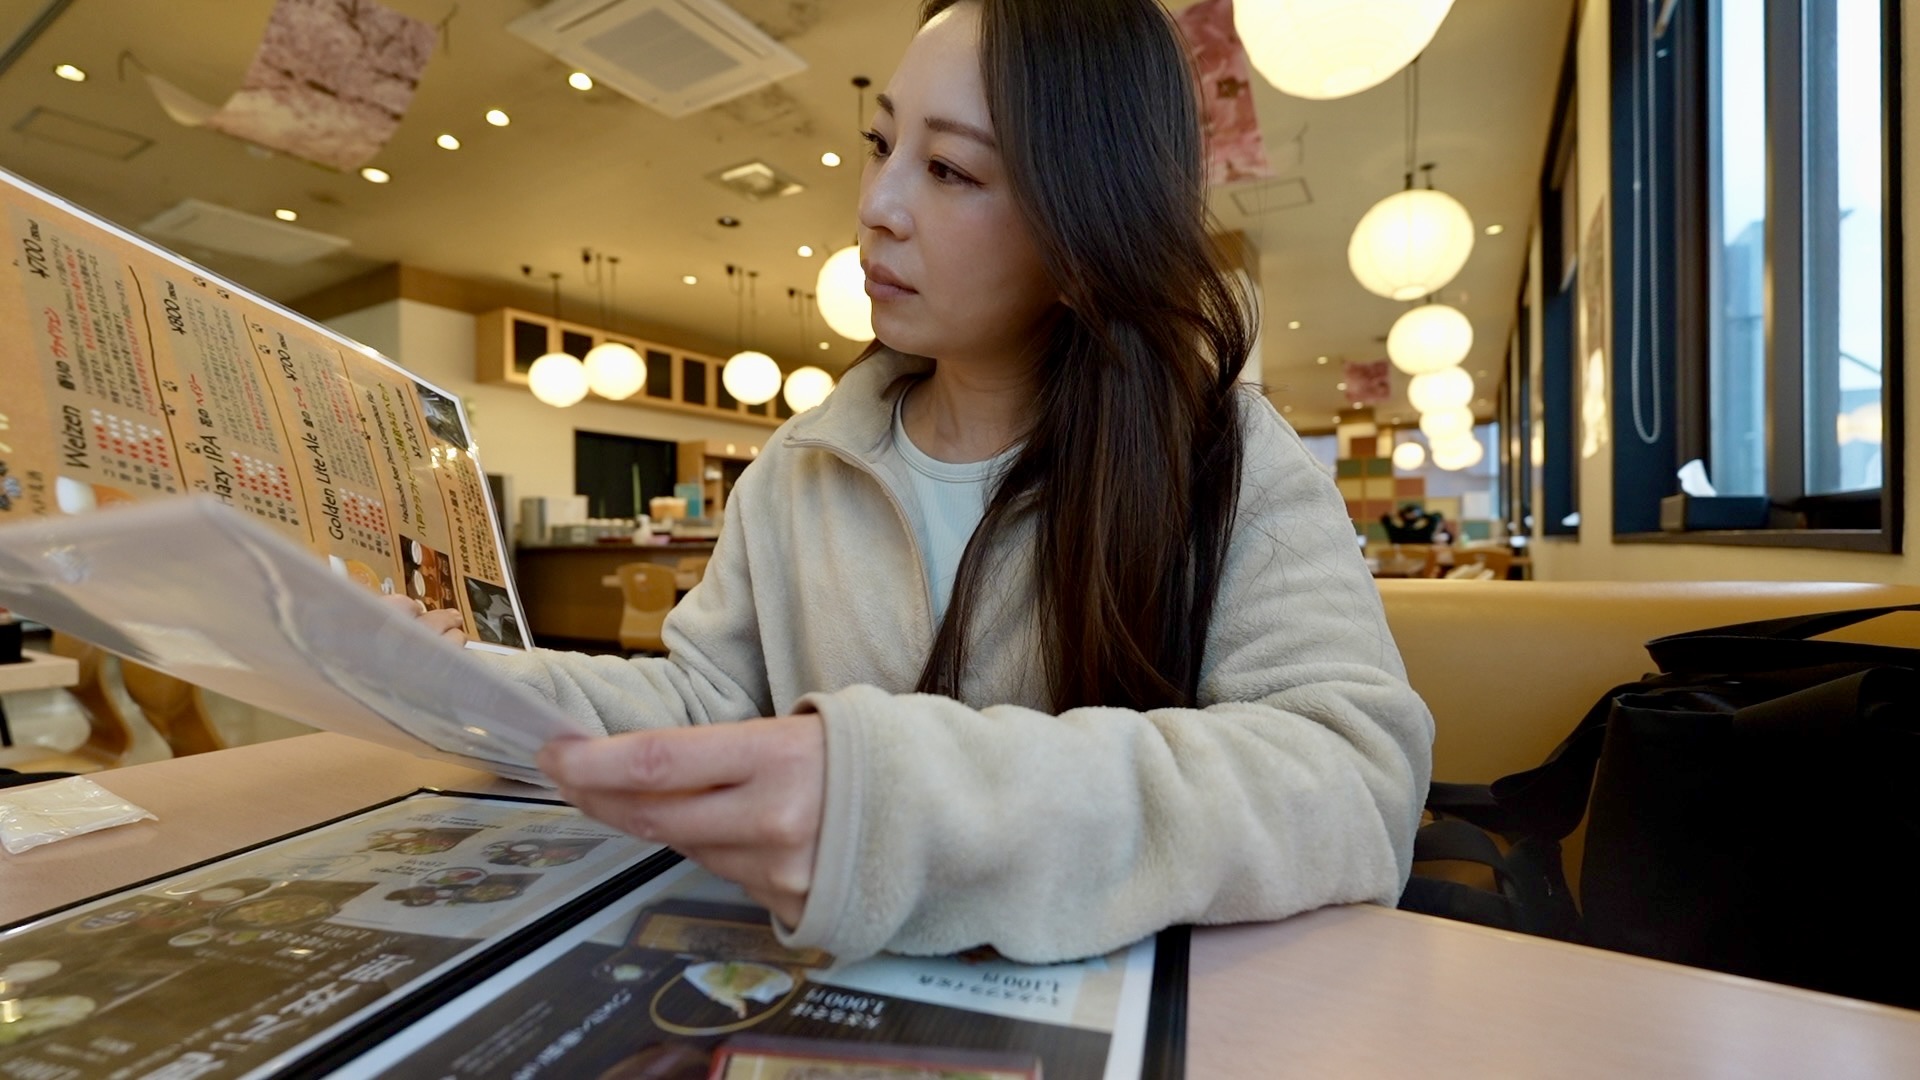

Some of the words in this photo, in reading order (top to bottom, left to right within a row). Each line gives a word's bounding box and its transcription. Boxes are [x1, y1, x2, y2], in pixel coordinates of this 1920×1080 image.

[23, 237, 50, 278] ¥700
[165, 297, 187, 335] ¥800
[280, 349, 298, 382] ¥700
[189, 372, 204, 406] ヘイジー
[294, 386, 307, 410] エール
[62, 405, 88, 469] Weizen
[203, 435, 223, 462] IPA
[304, 429, 322, 456] Ale
[405, 422, 423, 458] ¥1,200
[211, 464, 234, 508] Hazy
[314, 457, 330, 483] Lite
[324, 487, 344, 540] Golden
[982, 972, 1059, 994] 1,100円
[804, 988, 885, 1015] 1,000円
